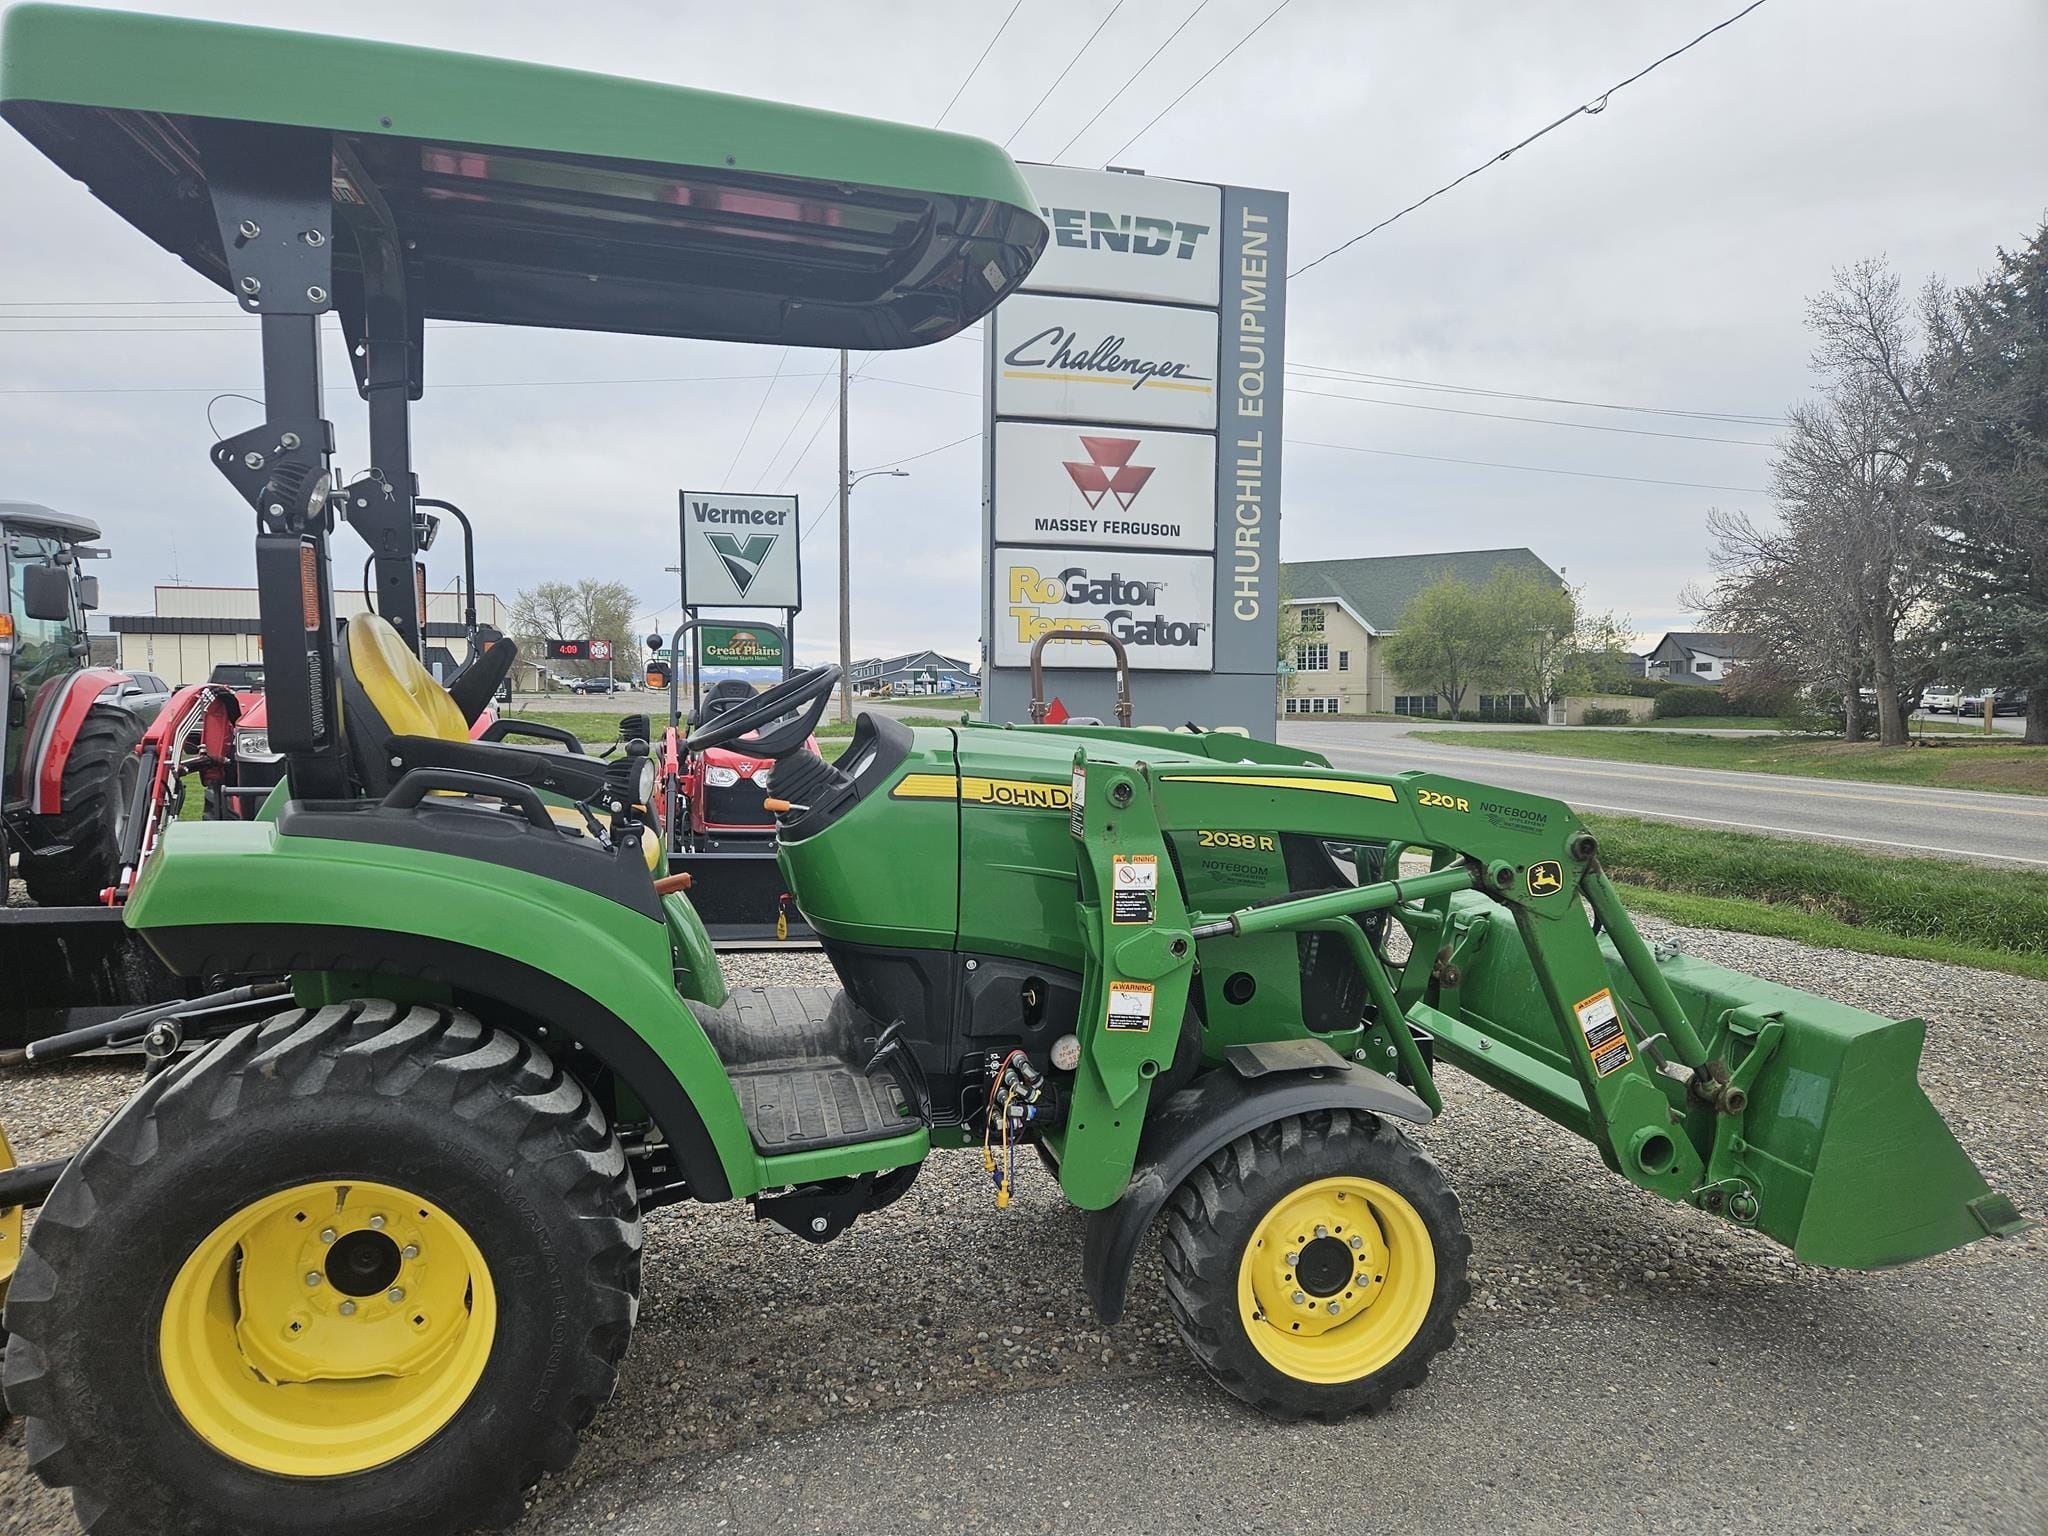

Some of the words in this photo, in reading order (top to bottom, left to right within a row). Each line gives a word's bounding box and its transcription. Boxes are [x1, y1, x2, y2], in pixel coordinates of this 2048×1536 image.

[1238, 206, 1268, 417] EQUIPMENT
[1004, 326, 1212, 390] Challenger
[692, 502, 786, 525] Vermeer
[1035, 518, 1098, 533] MASSEY
[1103, 520, 1180, 536] FERGUSON
[1234, 431, 1263, 620] CHURCHILL
[1009, 567, 1163, 606] RoGator
[1009, 607, 1206, 646] TerraGator
[706, 645, 741, 656] Great
[743, 645, 781, 656] Plains
[982, 783, 1047, 805] JOHN
[1050, 788, 1072, 807] D
[1417, 788, 1455, 808] 220
[1456, 797, 1470, 813] R
[1480, 802, 1548, 823] NOTEBOOM
[1197, 829, 1257, 850] 2038
[1259, 836, 1275, 852] R
[1202, 860, 1269, 876] NOTEBOOM
[1120, 983, 1153, 992] WARNING
